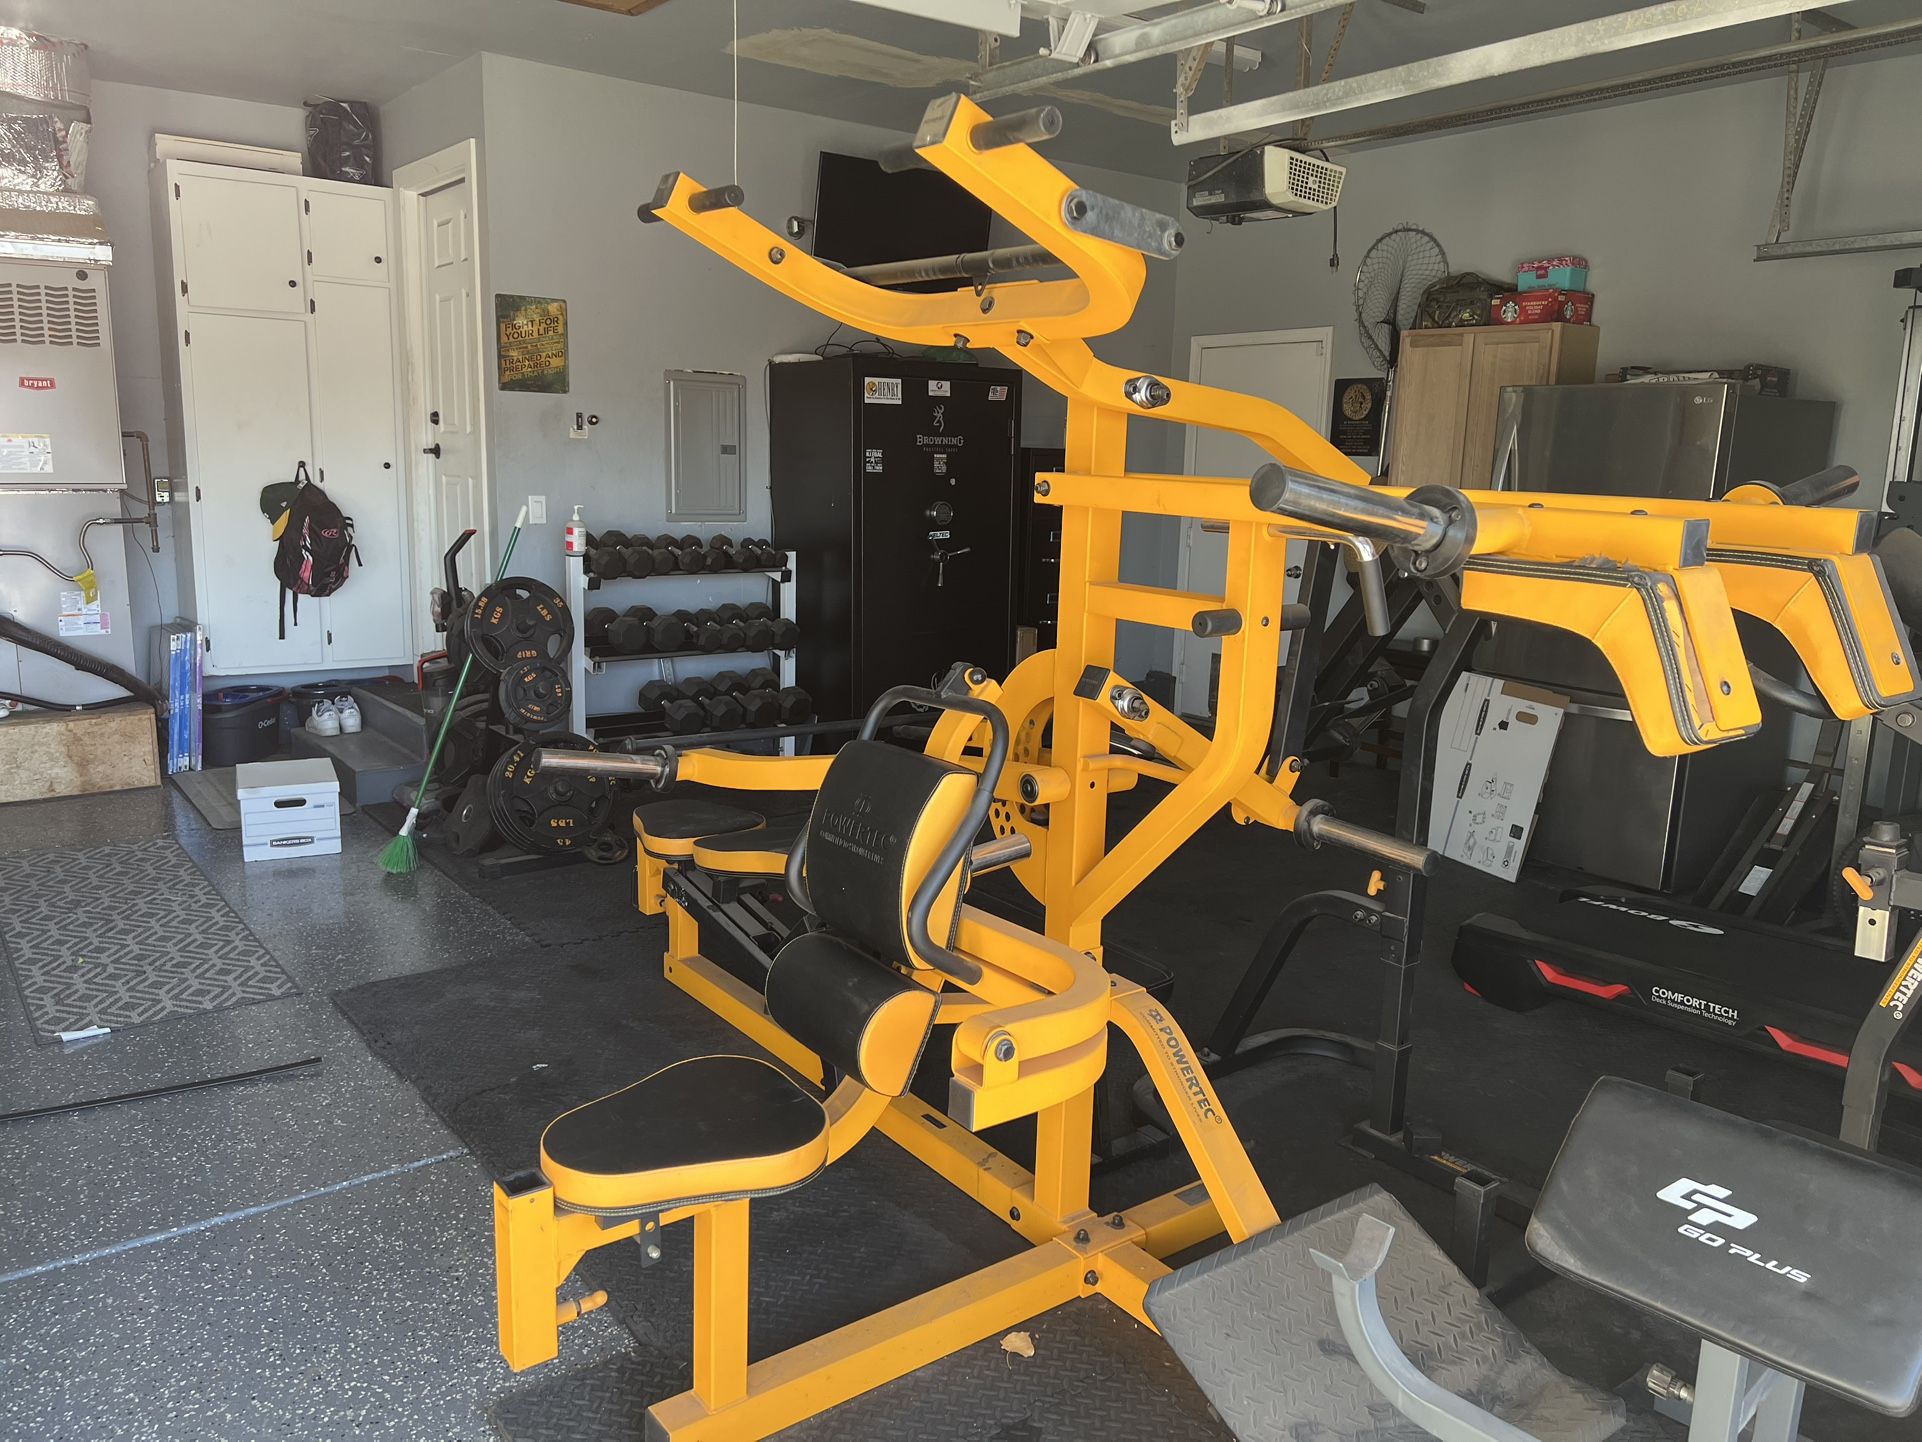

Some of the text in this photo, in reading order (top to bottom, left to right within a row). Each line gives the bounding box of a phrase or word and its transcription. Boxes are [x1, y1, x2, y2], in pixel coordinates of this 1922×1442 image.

[504, 316, 560, 332] FIGHT FOR
[504, 325, 559, 341] YOUR LIFE
[504, 350, 564, 366] TRAINED AND
[504, 360, 551, 374] PREPARED
[24, 379, 51, 388] bryant
[916, 434, 964, 446] BROWNING
[474, 596, 488, 619] 15.88
[553, 596, 564, 608] 35
[490, 606, 504, 625] KGS
[536, 604, 552, 622] LBS
[516, 650, 538, 659] GRIP
[504, 750, 524, 779] 20.41
[523, 764, 536, 784] KG
[550, 818, 574, 827] LBS
[1652, 986, 1738, 1020] COMFORT TECH
[1652, 995, 1736, 1026] Deck Suspension Technology
[1159, 1026, 1216, 1119] POWERTEC
[1678, 1224, 1812, 1283] GO PLUS
